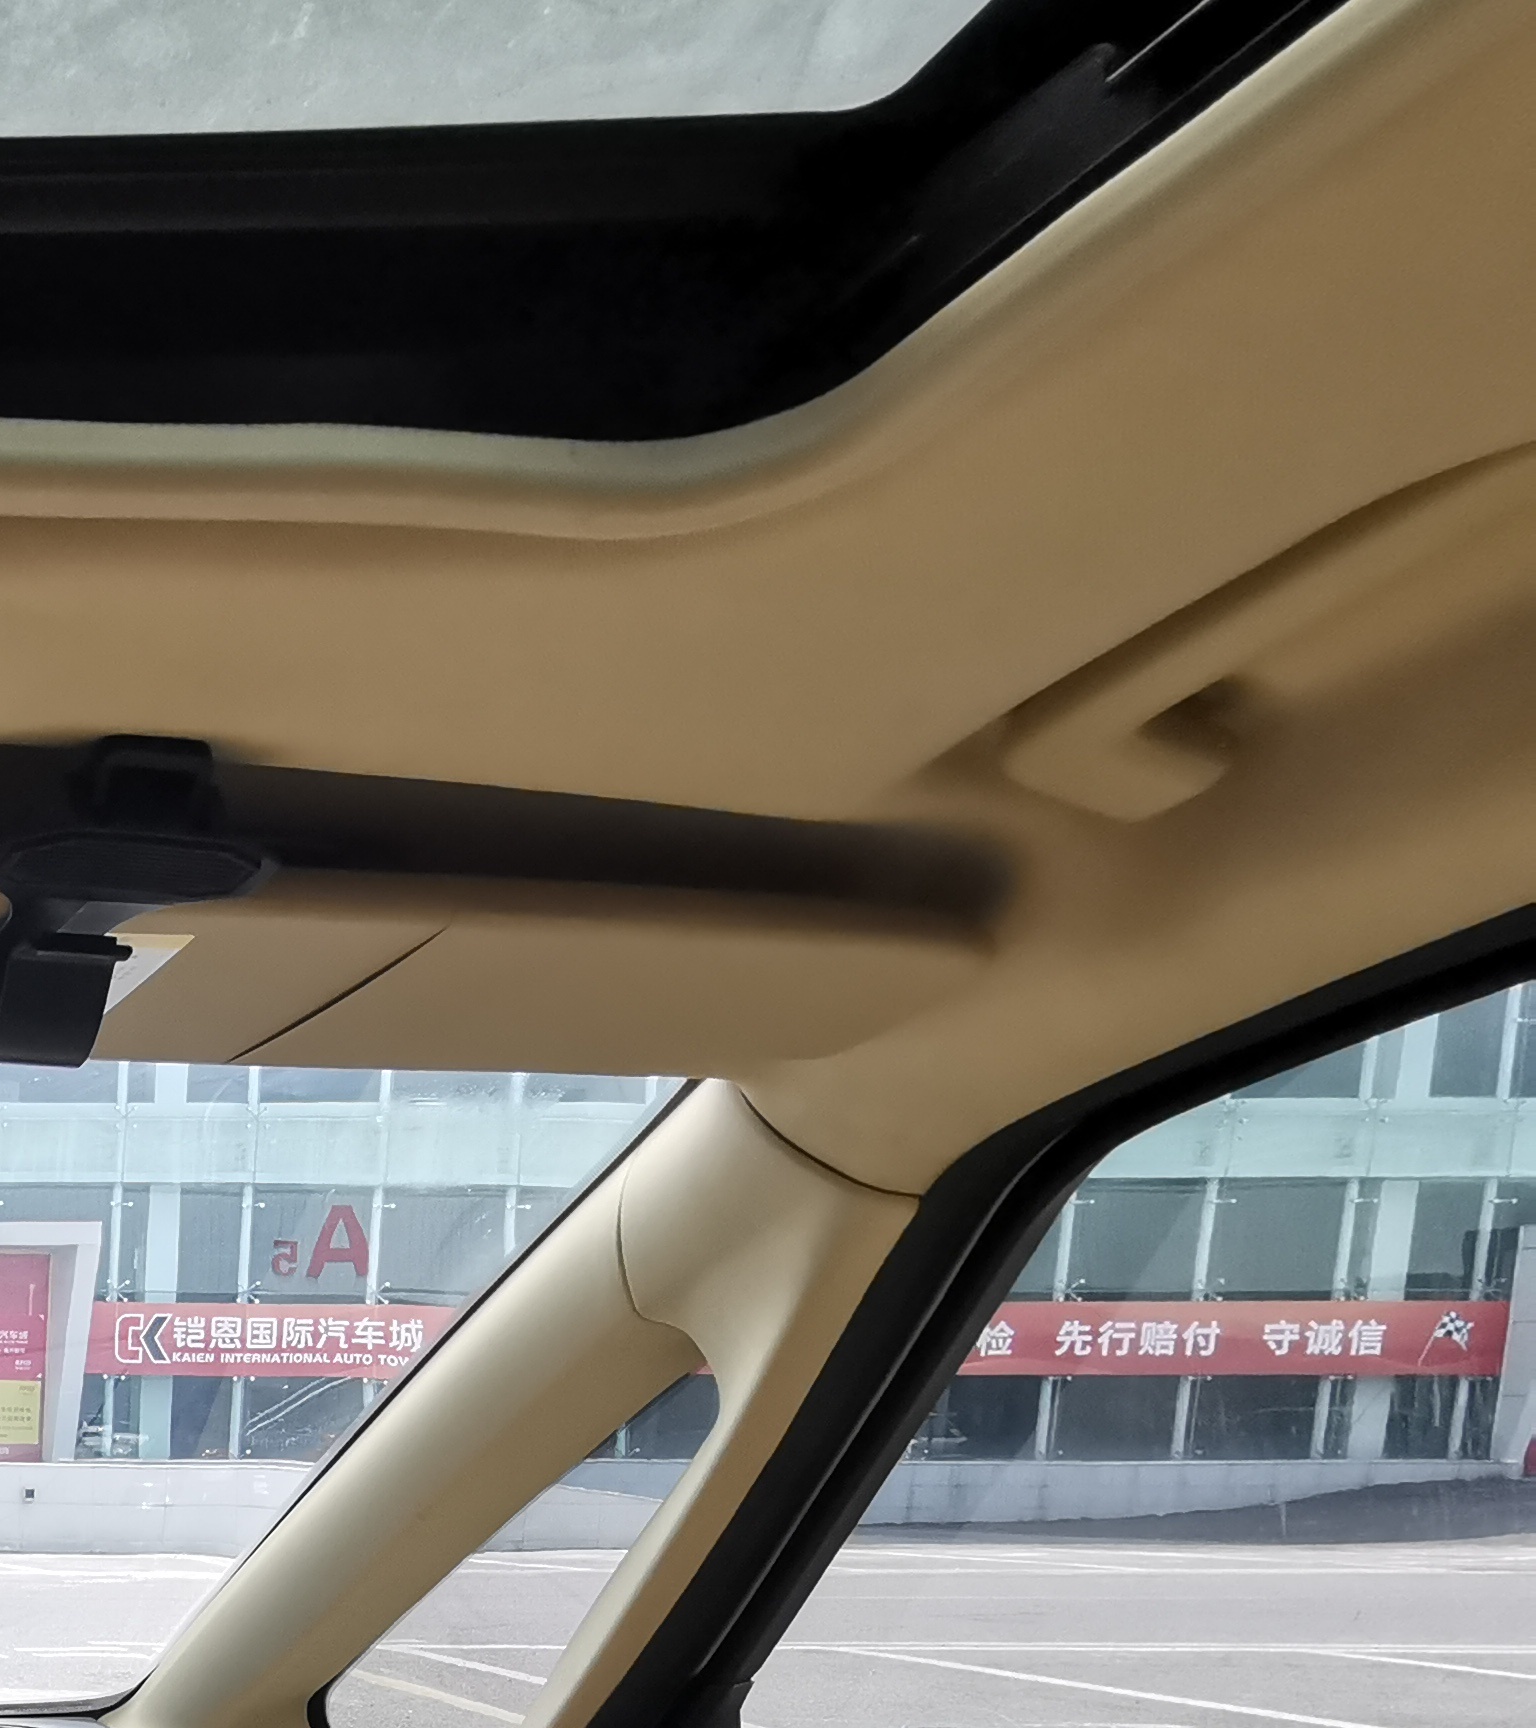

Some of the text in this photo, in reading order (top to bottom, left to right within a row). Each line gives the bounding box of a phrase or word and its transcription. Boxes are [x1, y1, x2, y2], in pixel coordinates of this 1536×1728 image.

[172, 1315, 425, 1352] 铠恩国际汽车城
[1054, 1319, 1223, 1358] 先行赔付
[1261, 1318, 1389, 1359] 守诚信
[171, 1351, 411, 1367] KAIEN INTERNATIONAL AUTO TO
